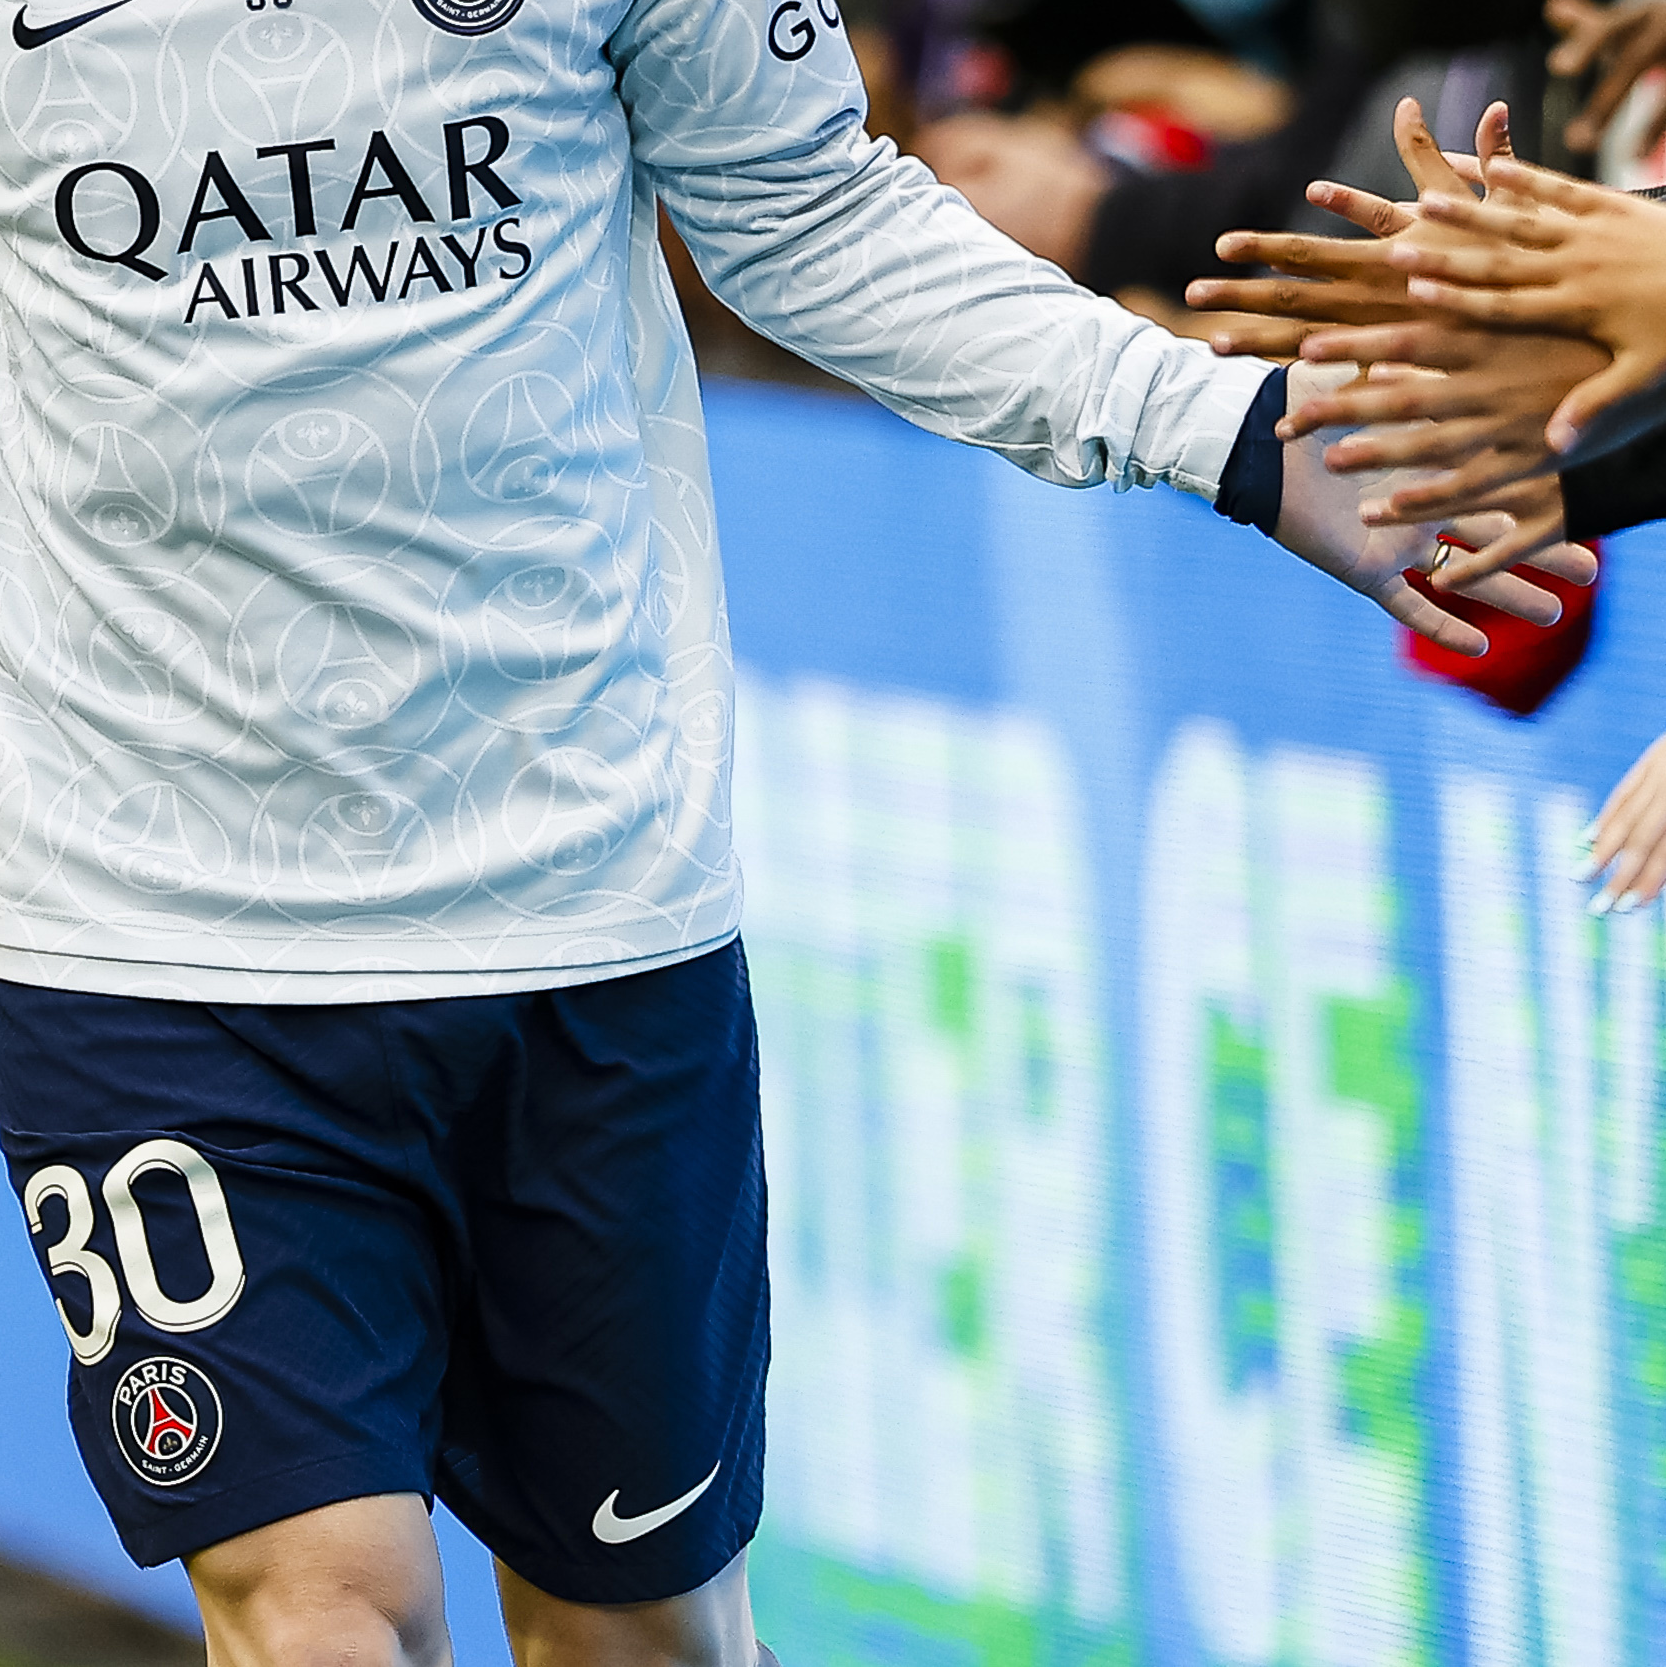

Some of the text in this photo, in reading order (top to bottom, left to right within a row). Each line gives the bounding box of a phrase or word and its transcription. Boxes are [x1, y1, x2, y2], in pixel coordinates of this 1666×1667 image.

[53, 114, 524, 283] QATAR
[183, 217, 532, 325] AIRWAYS
[24, 1138, 246, 1366] 30
[119, 1362, 188, 1406] PARIS
